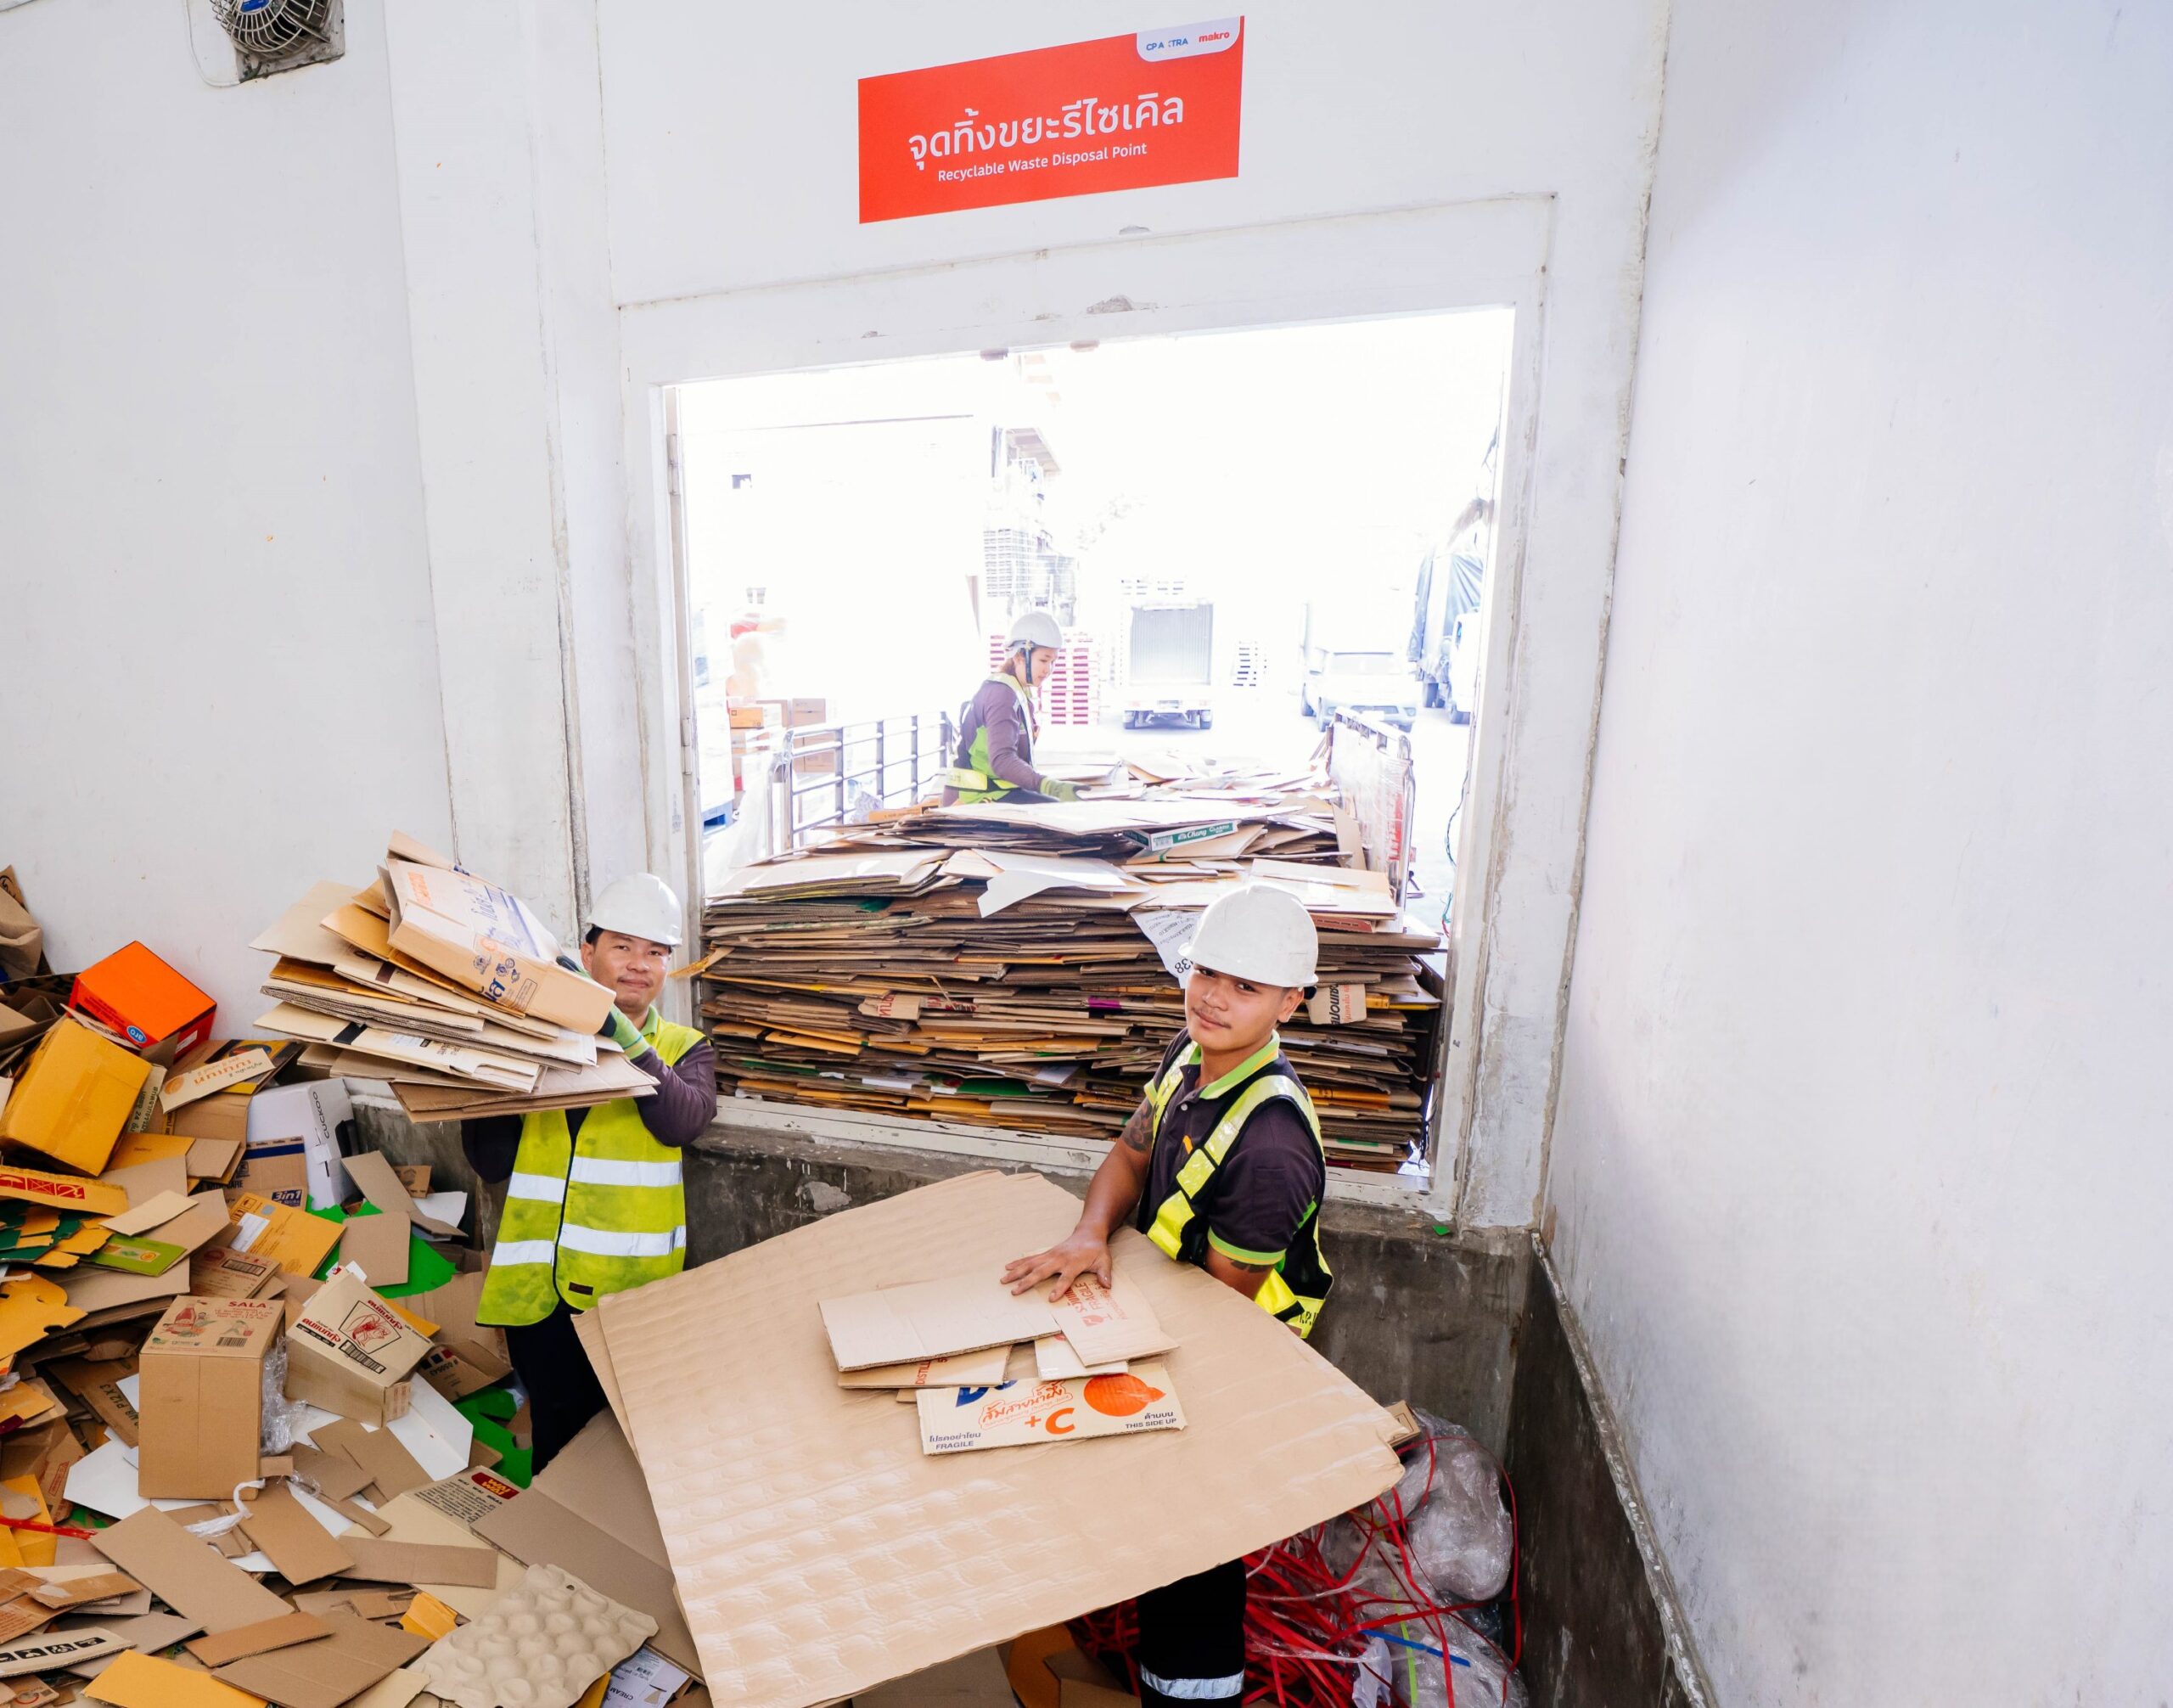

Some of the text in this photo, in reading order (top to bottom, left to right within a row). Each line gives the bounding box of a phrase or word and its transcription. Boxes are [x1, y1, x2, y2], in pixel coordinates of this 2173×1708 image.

[1198, 31, 1230, 42] makro
[1146, 42, 1157, 51] CP
[908, 92, 1184, 171] จุดทิ้งขยะรีไซเคิล
[937, 143, 1148, 183] Recyclable Waste Disposal Point
[1187, 829, 1207, 839] Chang
[1174, 958, 1193, 974] 38
[313, 1091, 329, 1138] CUCKOO
[274, 1190, 301, 1201] 3in1
[915, 1361, 931, 1385] DISTILL
[935, 1441, 974, 1450] FRAGILE
[481, 1481, 505, 1496] WAI
[487, 1478, 511, 1493] WAI
[609, 1687, 634, 1701] CREAM
